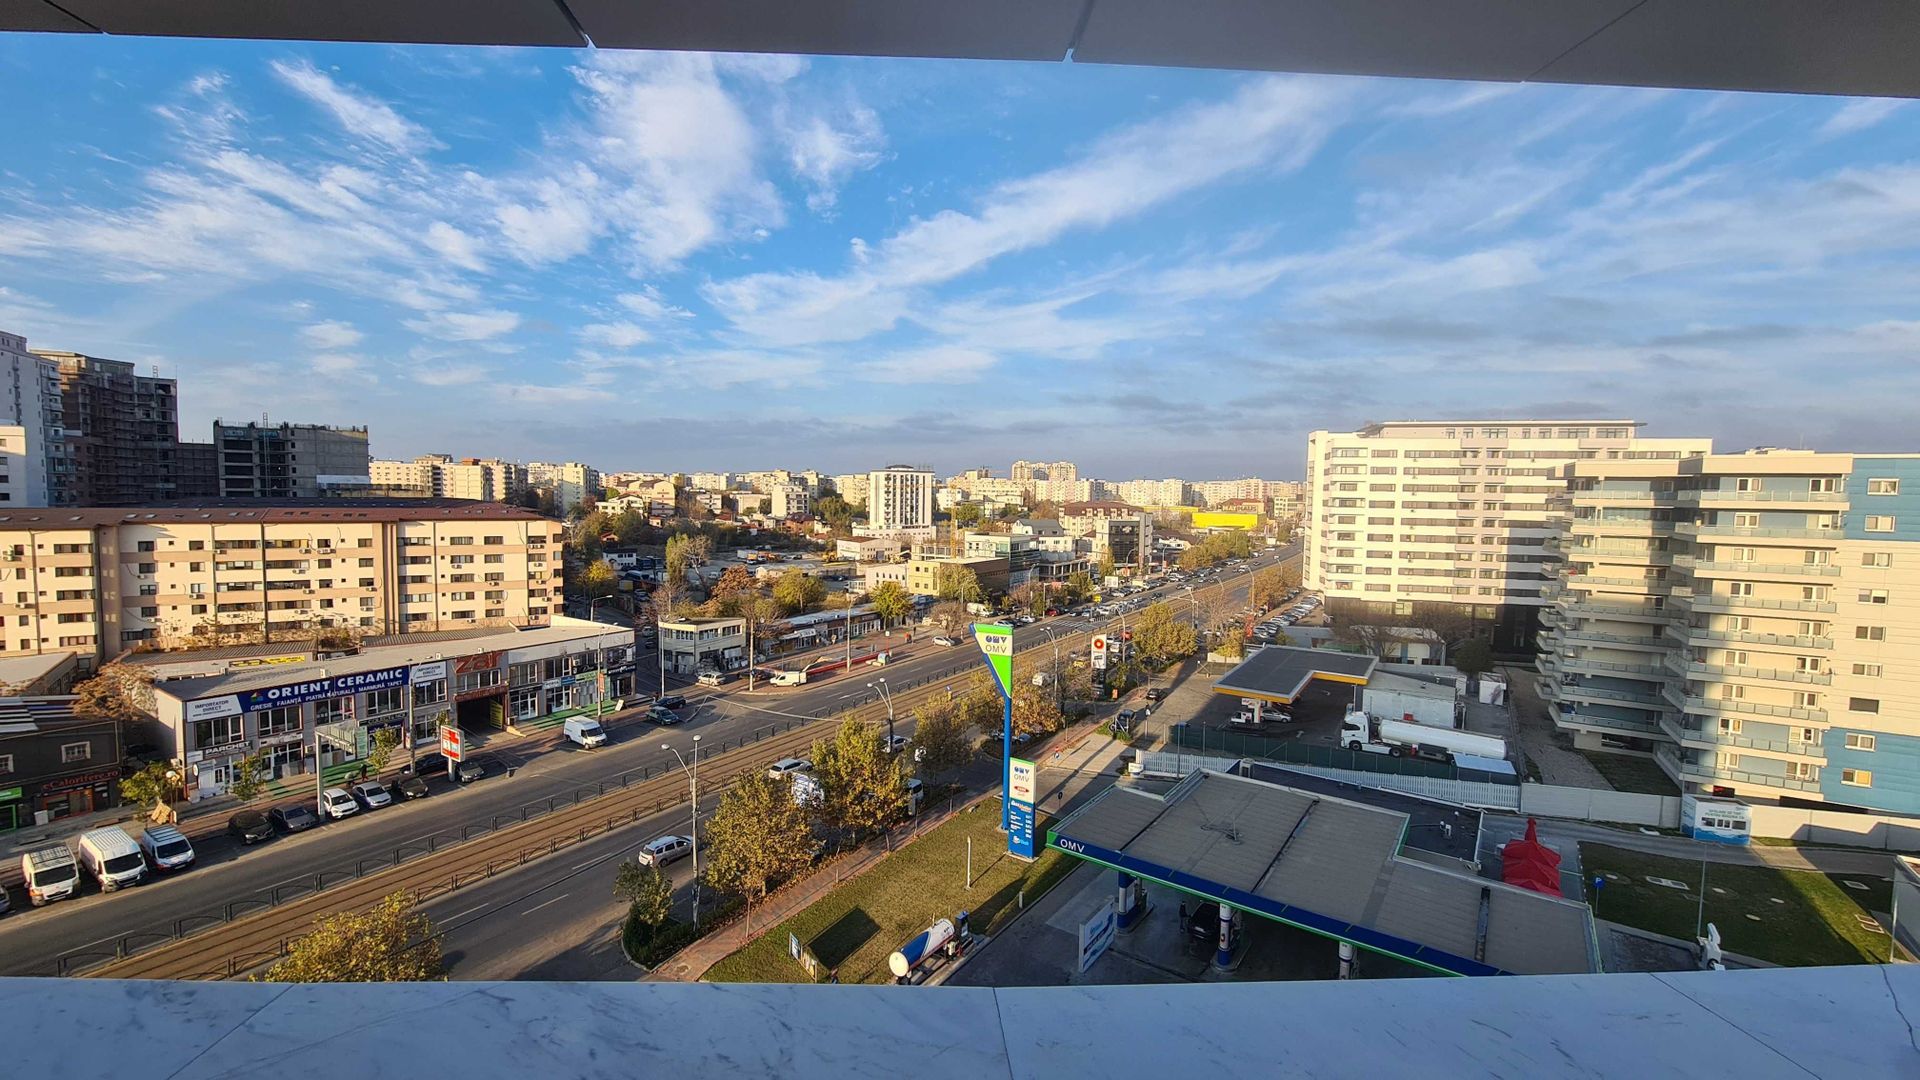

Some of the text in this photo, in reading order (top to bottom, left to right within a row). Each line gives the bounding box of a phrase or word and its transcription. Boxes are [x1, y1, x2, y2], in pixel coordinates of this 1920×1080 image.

[985, 644, 1007, 654] OMV
[267, 668, 403, 699] ORIENT CERAMIC
[250, 702, 273, 712] GRESIE
[387, 680, 403, 688] TAPET
[194, 700, 230, 709] IMPORTATOR
[205, 741, 251, 754] PARCHET
[1013, 774, 1030, 783] OMV
[1060, 838, 1085, 853] OMV
